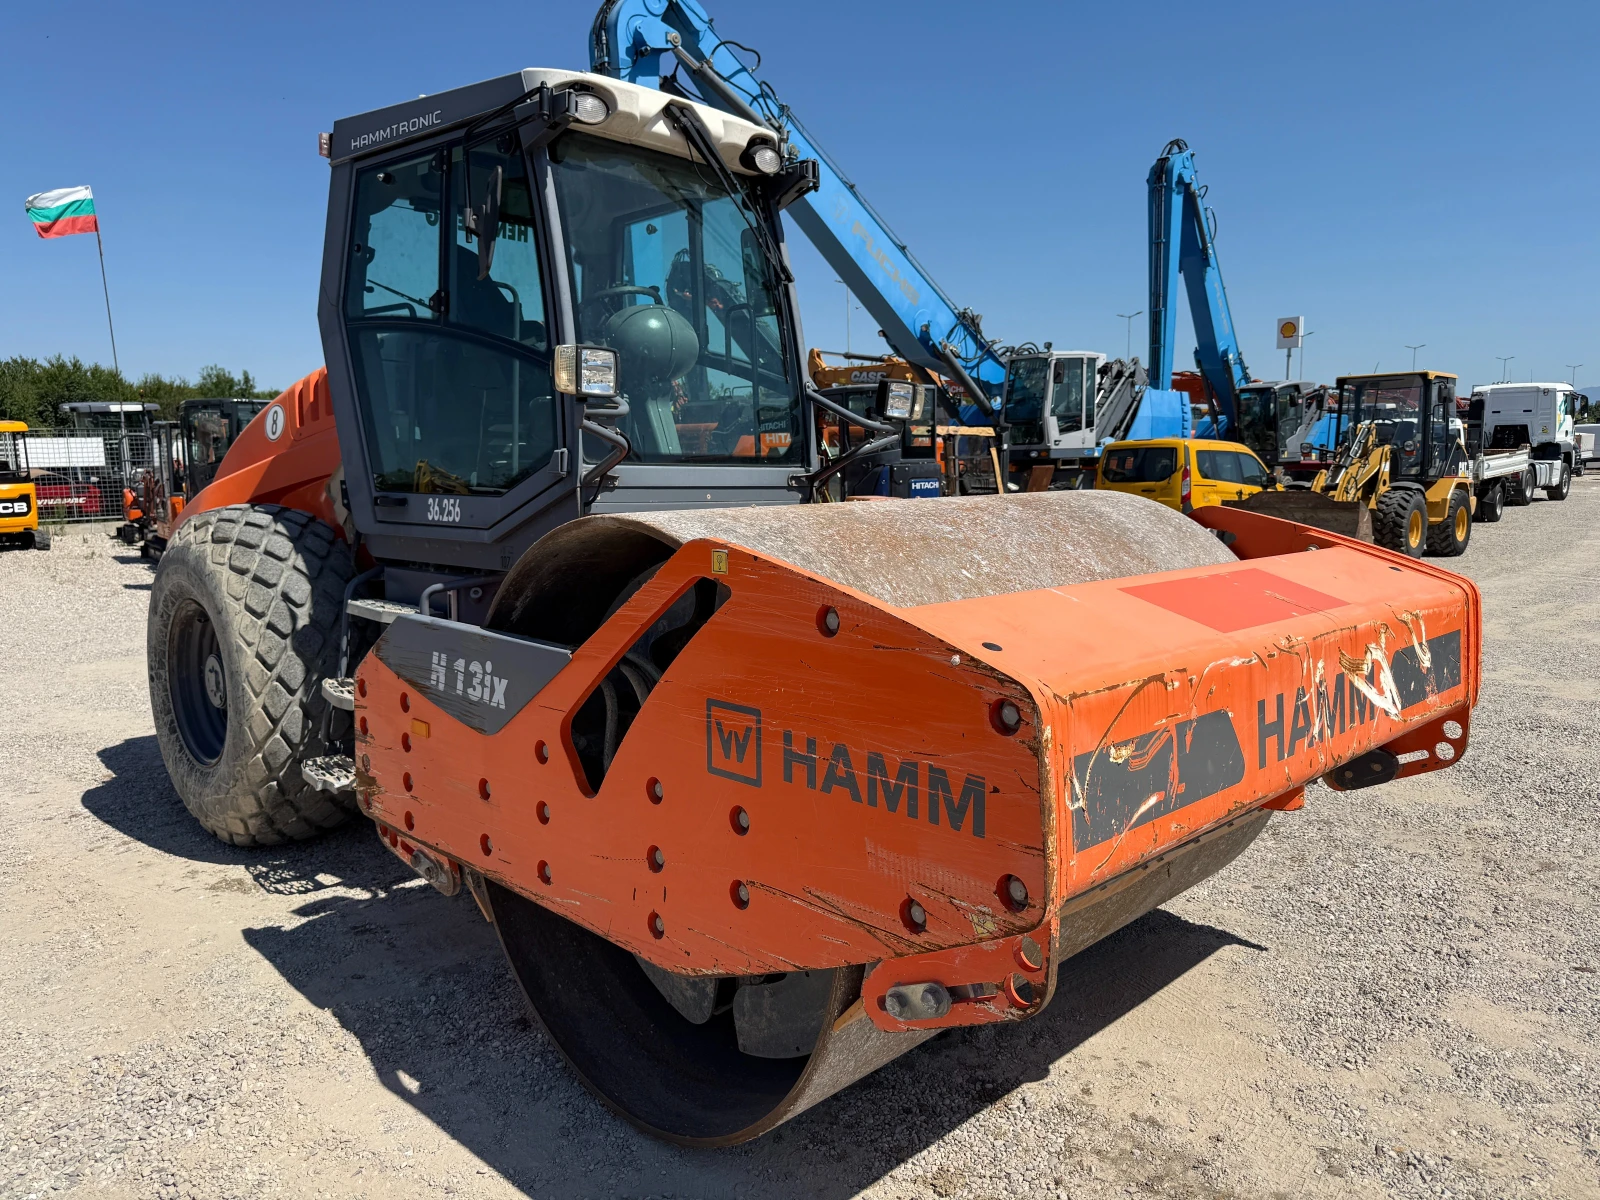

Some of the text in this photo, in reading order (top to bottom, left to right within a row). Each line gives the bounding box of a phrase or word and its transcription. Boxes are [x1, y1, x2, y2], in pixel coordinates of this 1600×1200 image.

[351, 110, 442, 150] HAMMTRONIC
[271, 410, 279, 436] 8
[911, 481, 939, 490] HITACHI
[0, 502, 28, 514] CB
[427, 497, 461, 522] 36.256
[430, 651, 509, 710] H 13ix
[1257, 660, 1376, 770] HAMM
[783, 729, 986, 839] HAMM
